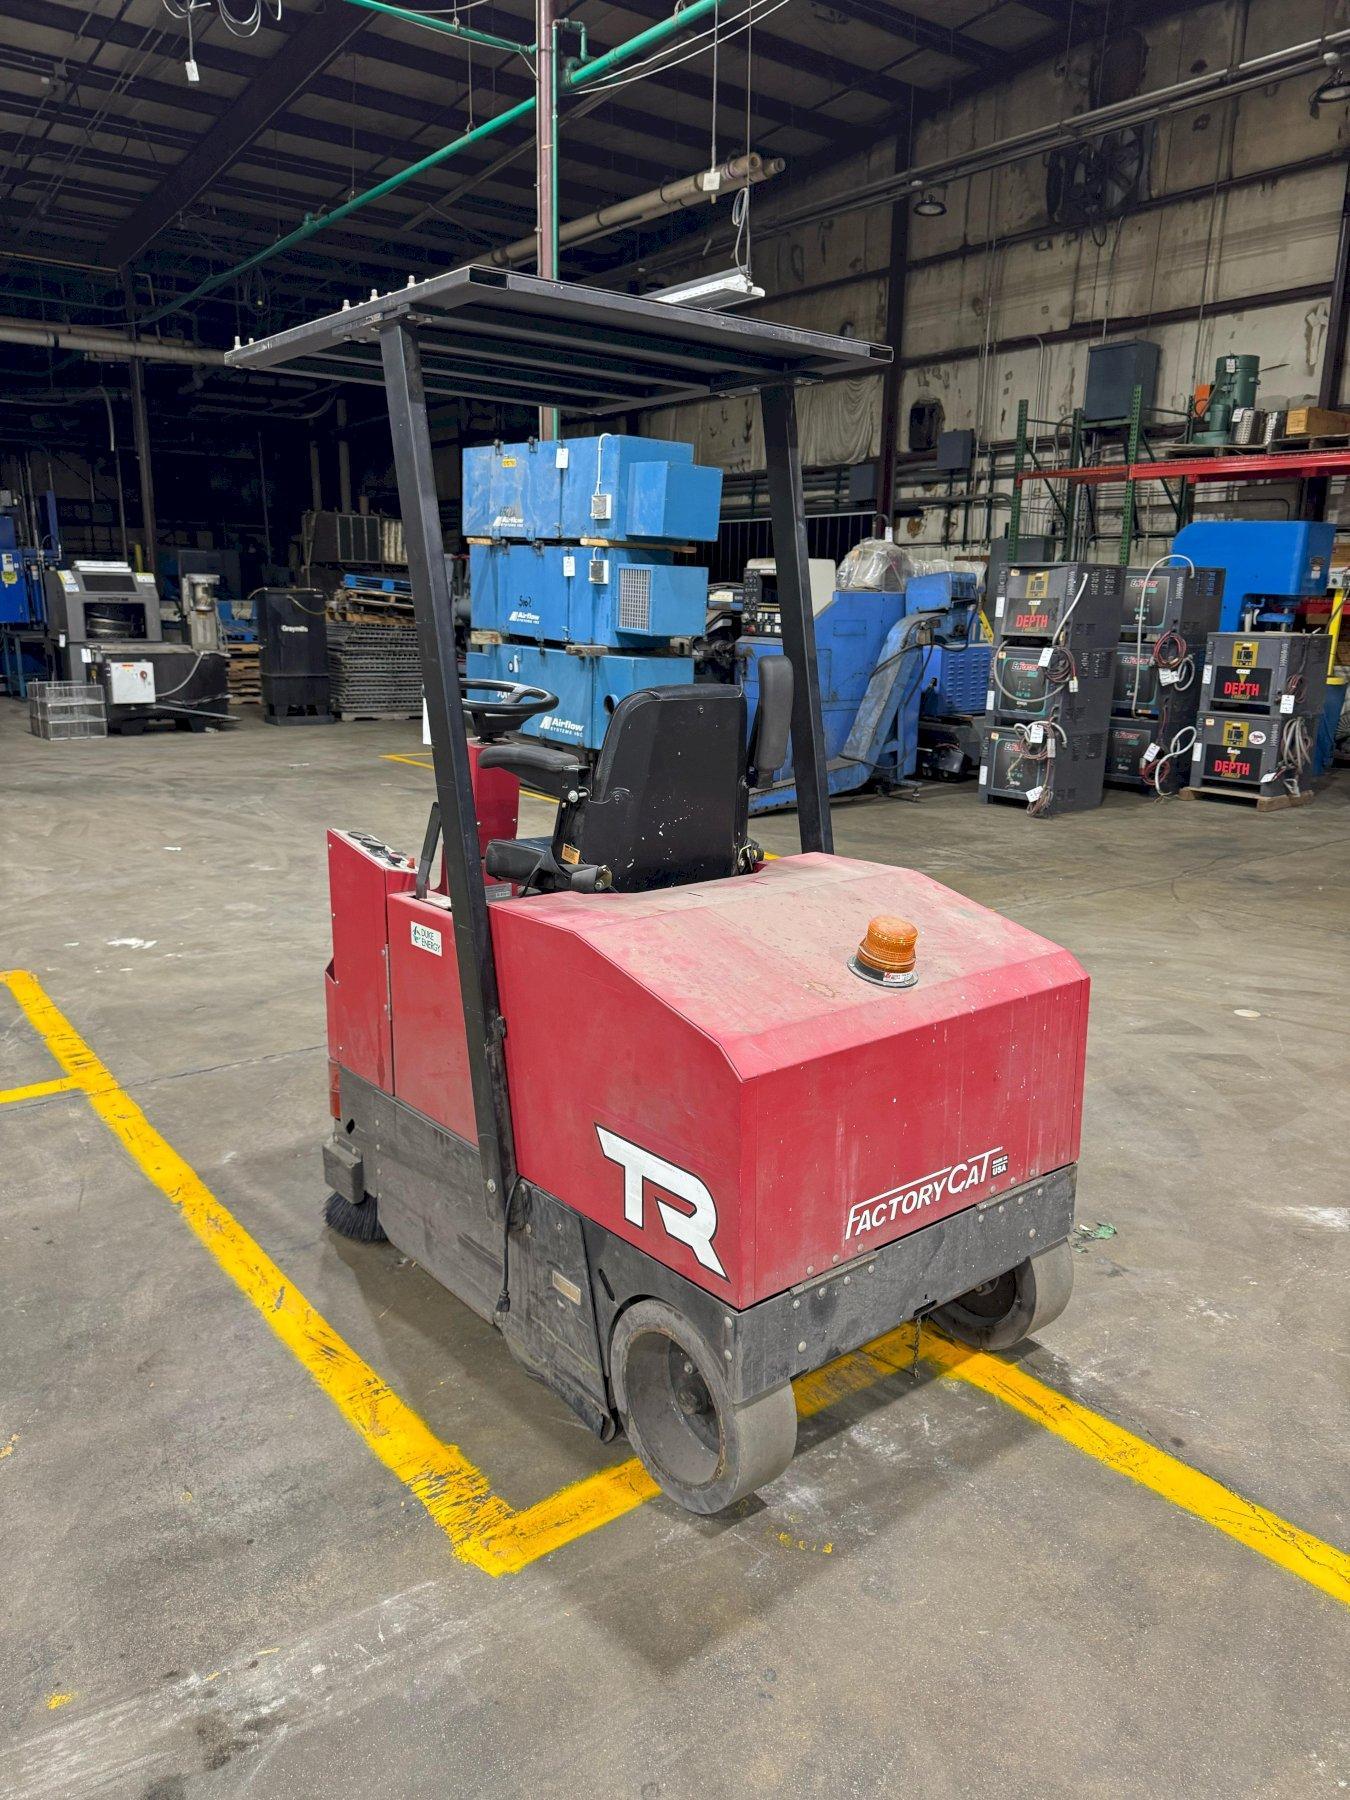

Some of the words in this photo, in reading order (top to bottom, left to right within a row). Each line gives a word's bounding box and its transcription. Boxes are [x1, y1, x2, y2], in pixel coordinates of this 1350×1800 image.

[1015, 614, 1048, 627] DEPTH
[1224, 682, 1260, 696] DEPTH
[552, 717, 584, 732] Airflow
[1214, 760, 1250, 775] DEPTH
[420, 929, 434, 941] DUKE
[421, 938, 440, 952] ENERGY
[992, 1163, 1007, 1176] USA
